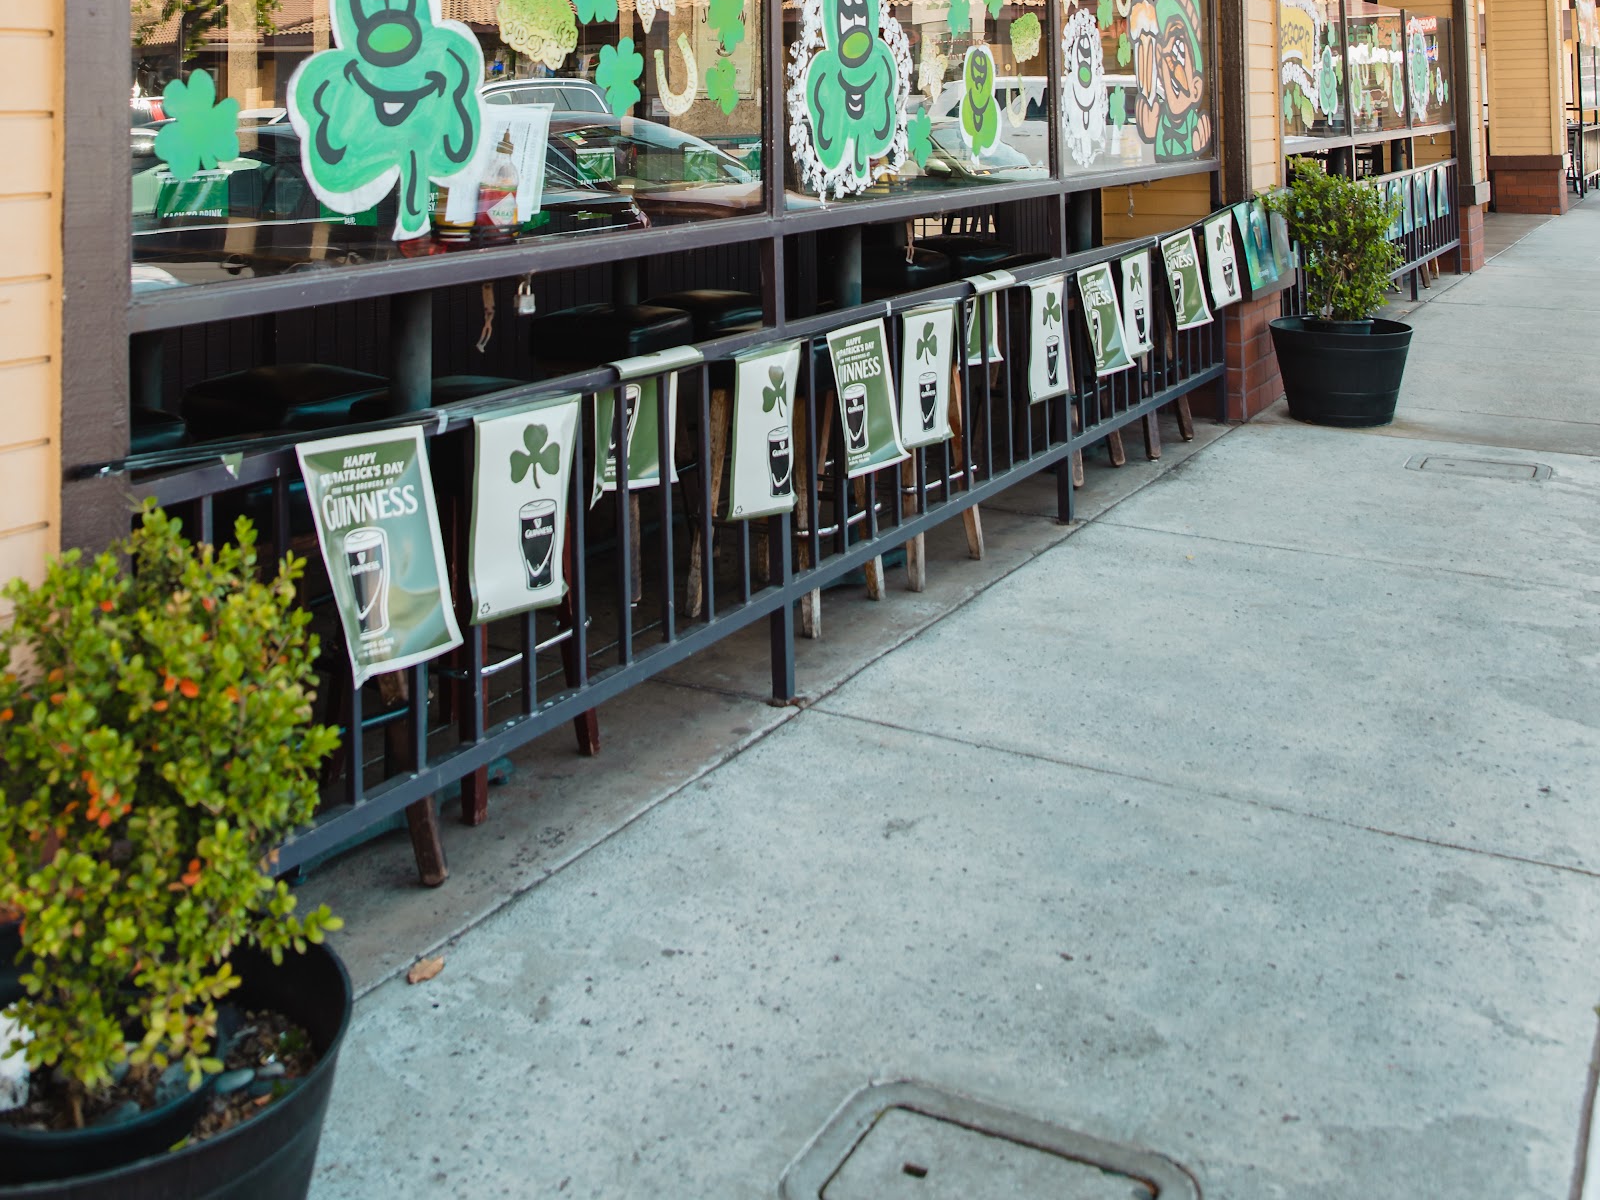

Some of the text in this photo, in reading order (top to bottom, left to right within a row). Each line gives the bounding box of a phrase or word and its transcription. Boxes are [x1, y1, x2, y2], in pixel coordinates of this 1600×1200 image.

[343, 451, 377, 469] HAPPY
[383, 460, 405, 475] DAY
[321, 484, 419, 532] GUINNESS
[524, 524, 554, 540] GUINNESS
